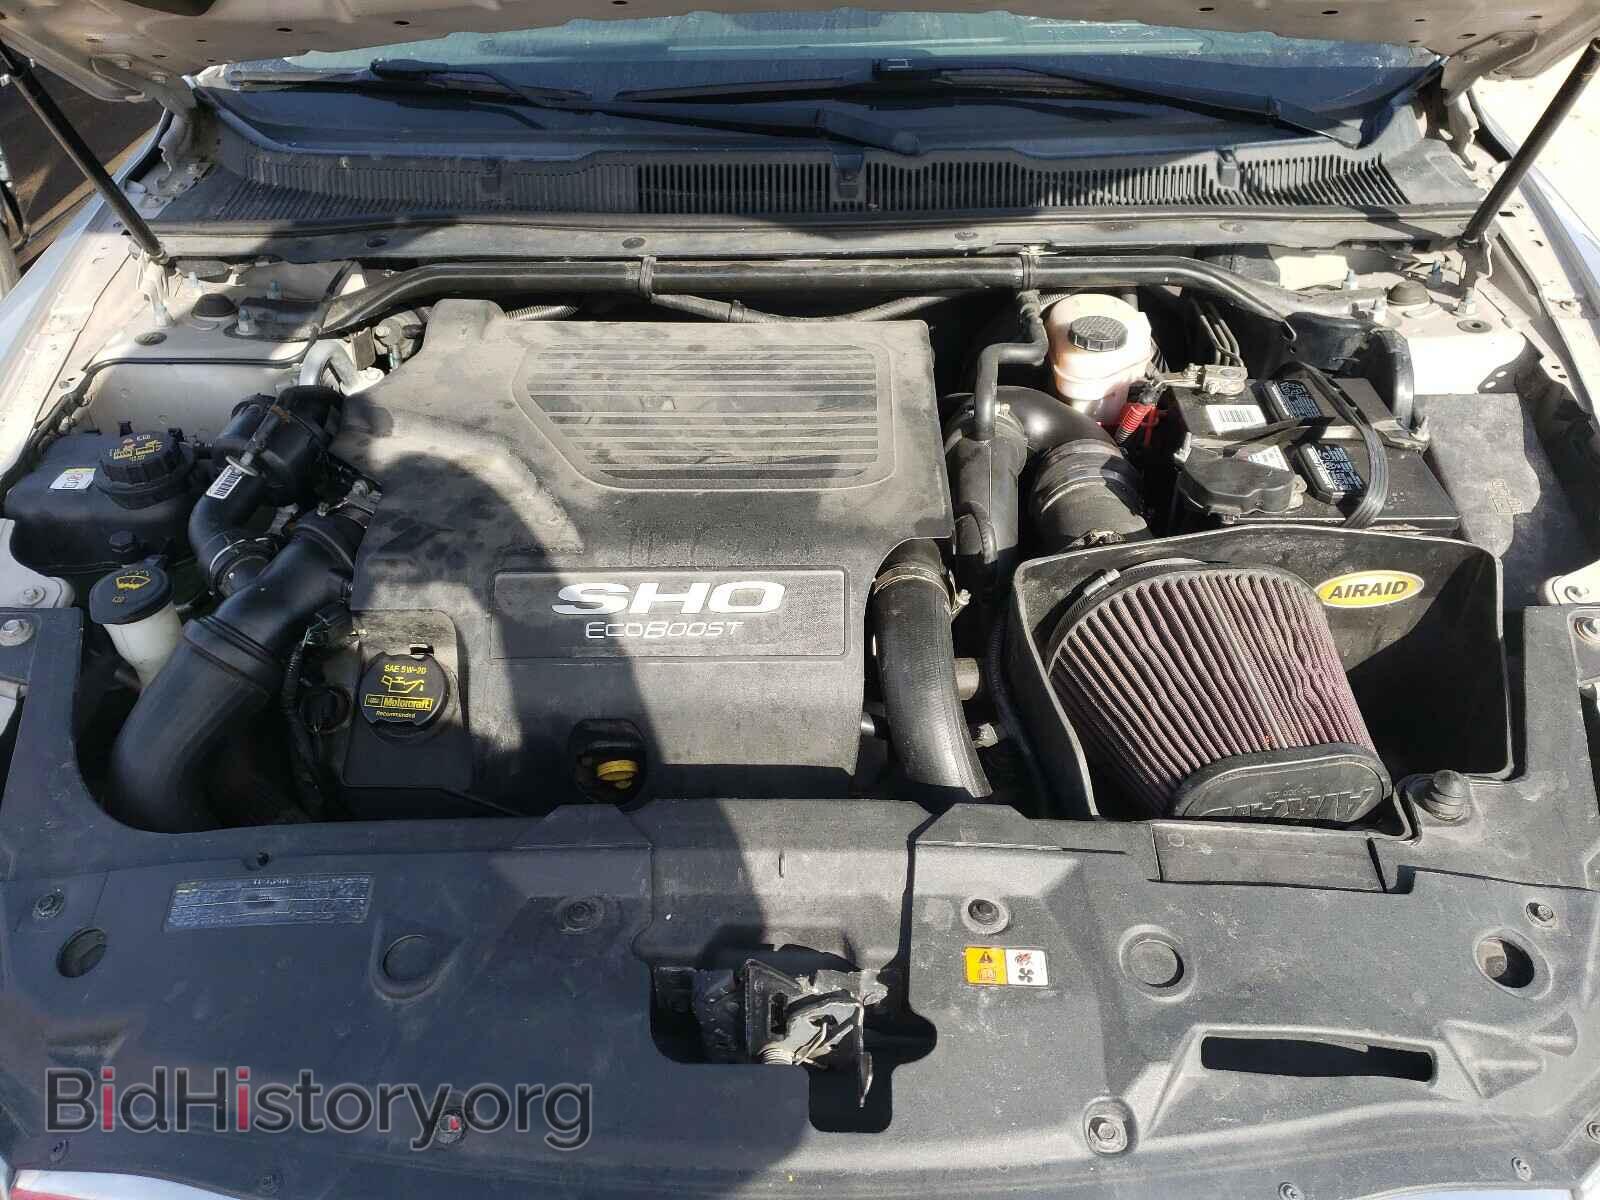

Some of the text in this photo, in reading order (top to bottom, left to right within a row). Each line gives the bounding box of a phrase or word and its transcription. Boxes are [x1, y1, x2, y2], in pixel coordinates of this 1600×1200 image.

[552, 580, 786, 615] SHO
[1327, 580, 1409, 600] AIRAID
[585, 621, 744, 639] ECOBOOST
[384, 664, 400, 673] SAE
[383, 697, 431, 709] Motorcraft
